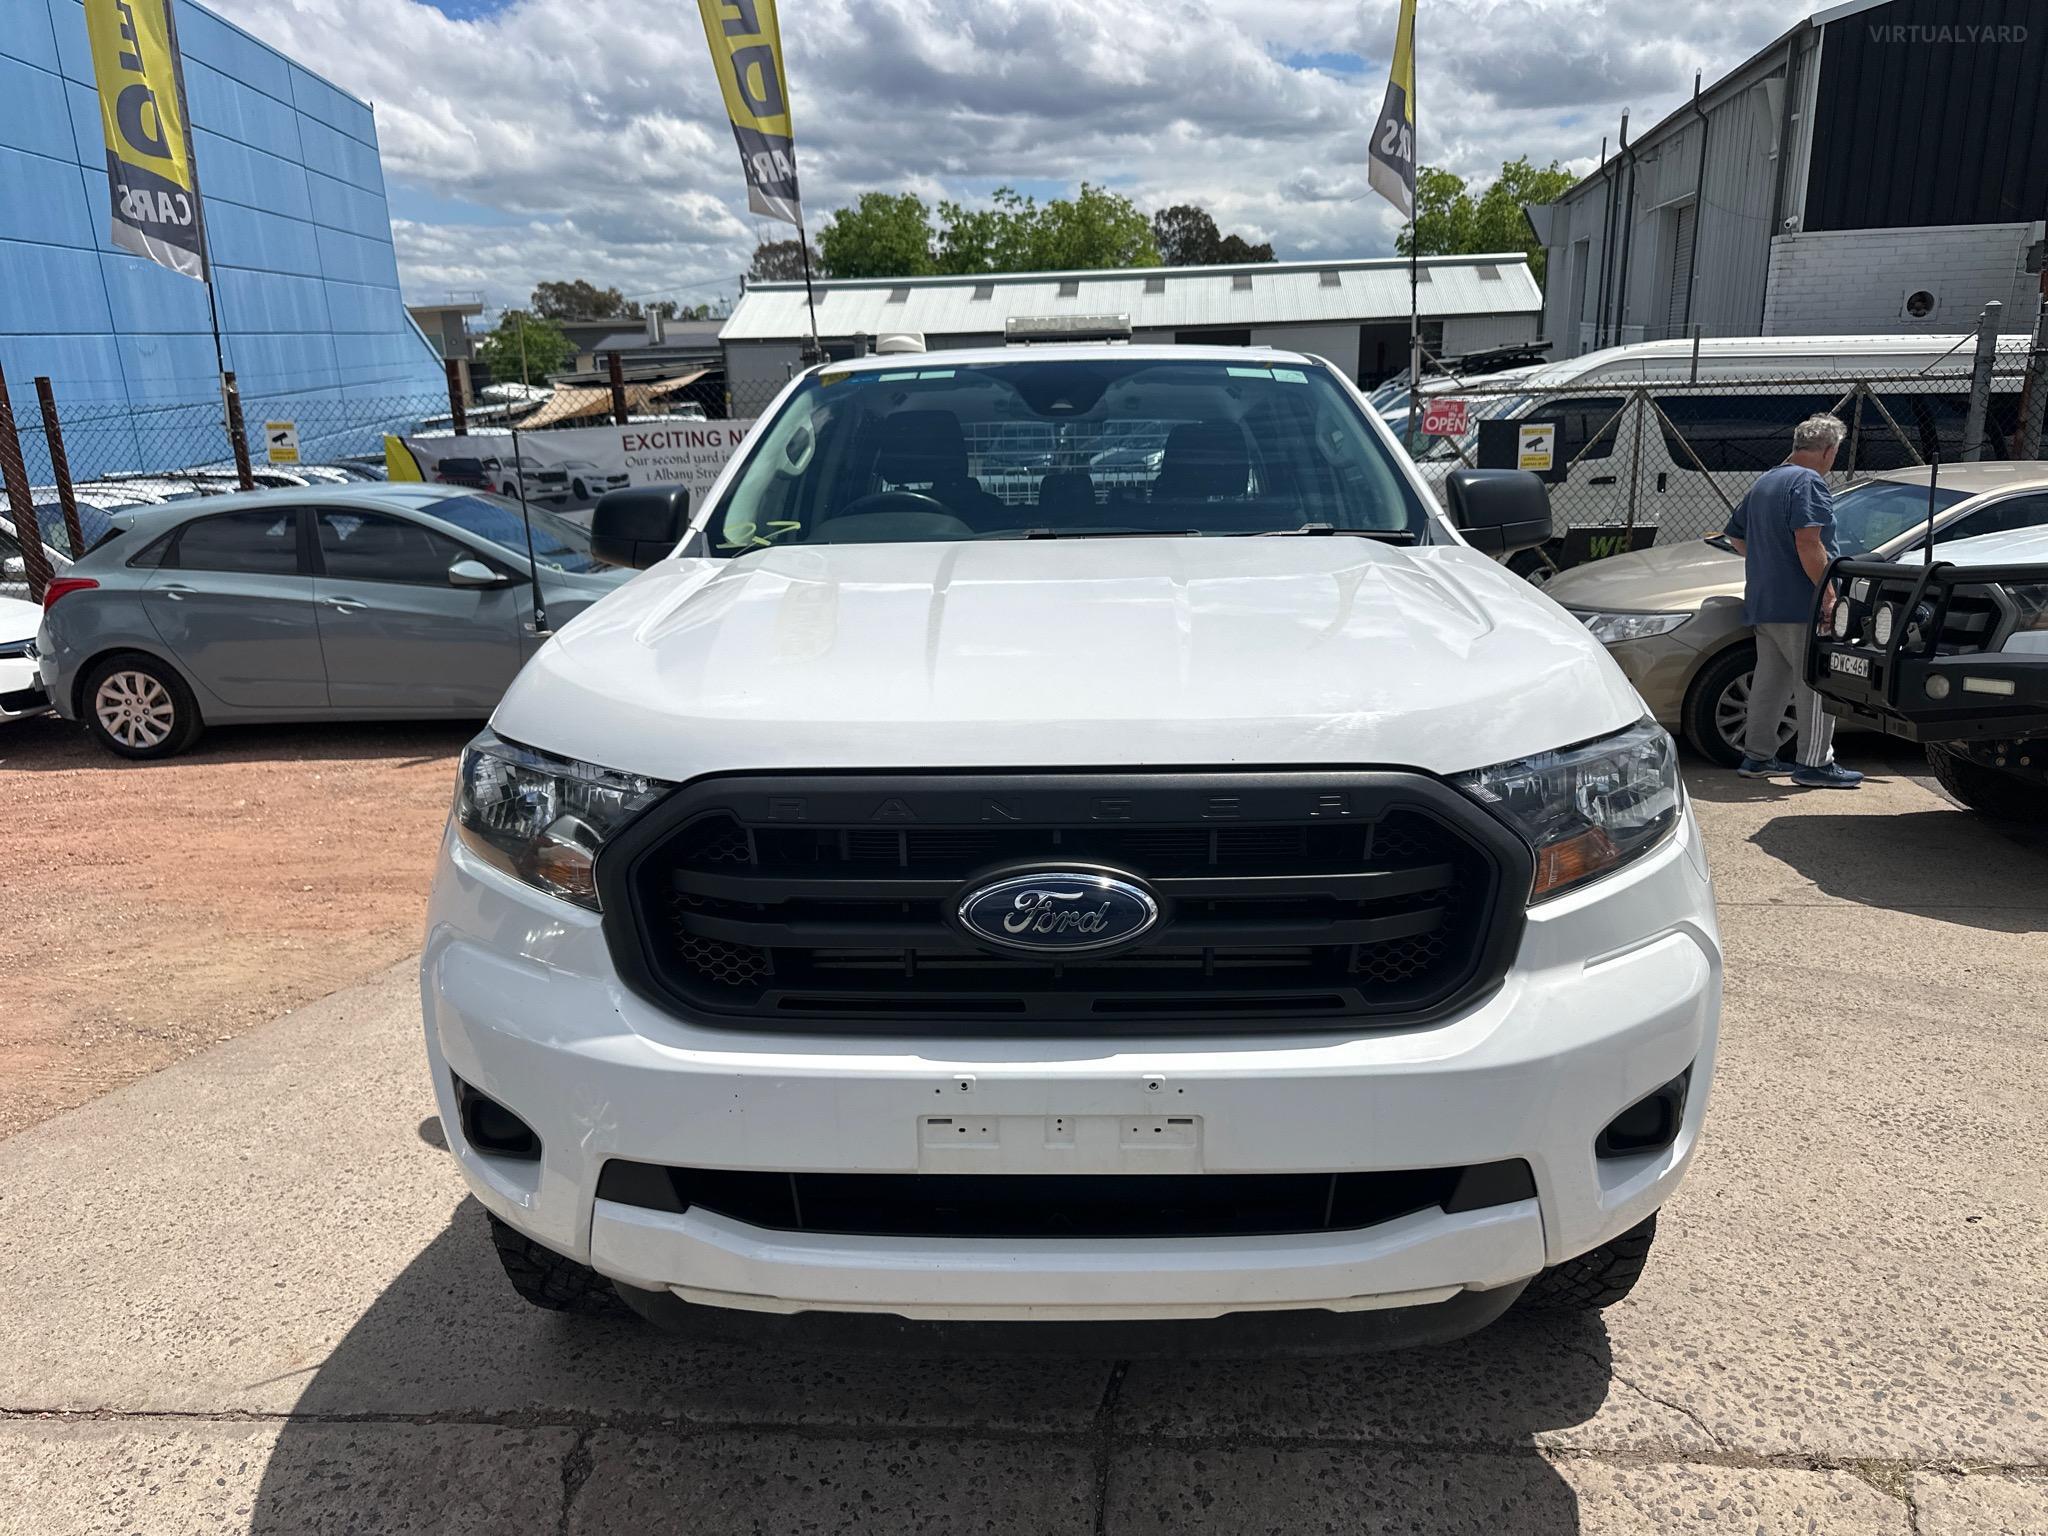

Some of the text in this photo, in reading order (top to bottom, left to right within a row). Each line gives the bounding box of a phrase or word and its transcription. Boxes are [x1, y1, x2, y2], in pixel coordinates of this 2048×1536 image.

[1425, 416, 1466, 432] OPEN
[622, 429, 750, 451] EXCITING N
[625, 456, 650, 468] Our
[652, 451, 691, 466] second
[693, 450, 719, 468] yard
[653, 467, 694, 483] Albany
[766, 793, 1352, 820] RANGER
[1003, 889, 1110, 934] Ford
